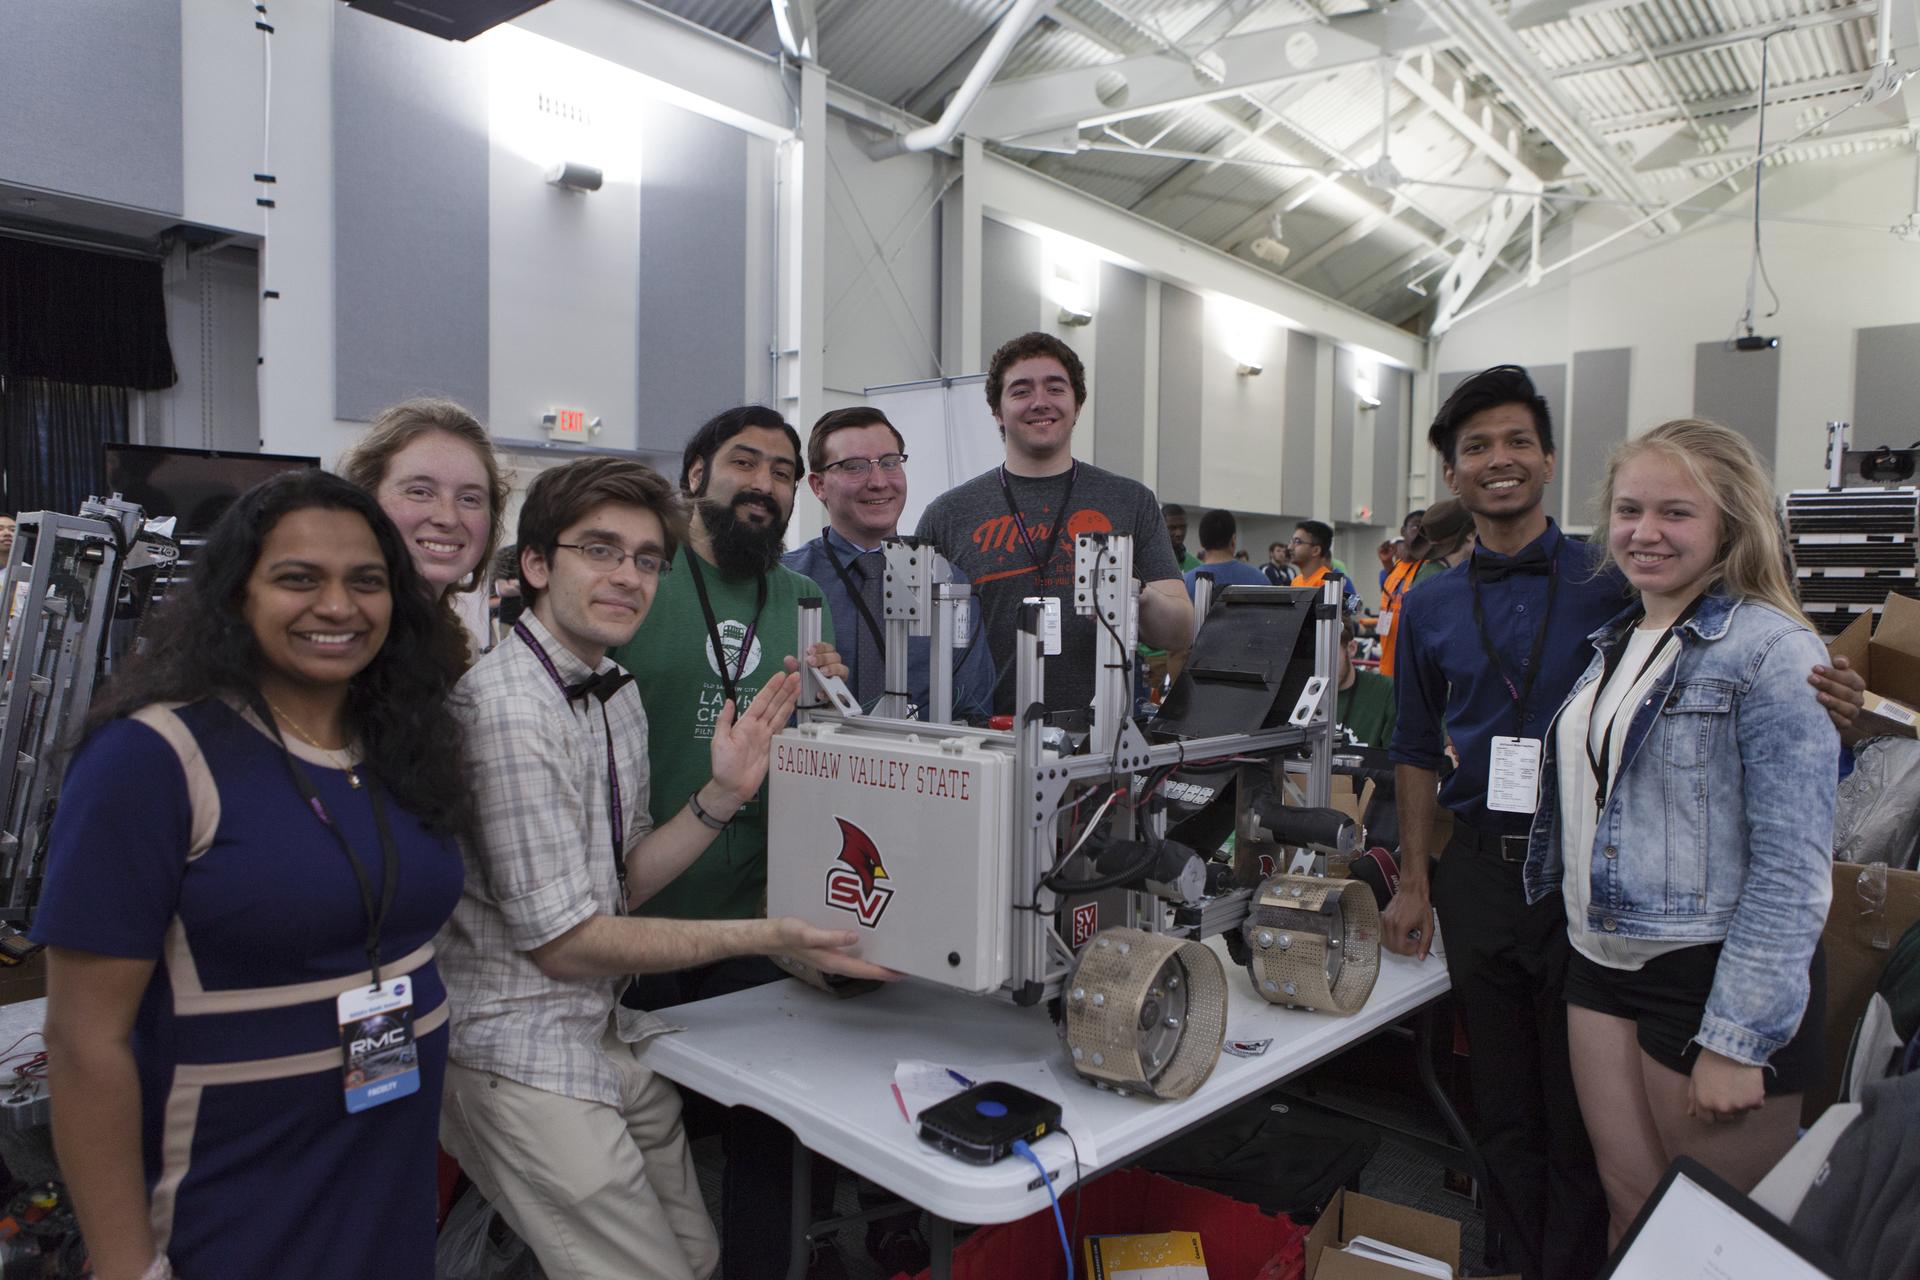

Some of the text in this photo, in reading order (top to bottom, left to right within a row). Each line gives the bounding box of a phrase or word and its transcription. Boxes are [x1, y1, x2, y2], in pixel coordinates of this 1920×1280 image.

[559, 409, 584, 432] EXIT
[777, 745, 970, 801] SAGINAW VALLEY STATE
[1076, 907, 1095, 927] SV
[1076, 923, 1095, 942] SU
[349, 1027, 405, 1056] RMC
[367, 1081, 398, 1097] FACULTY
